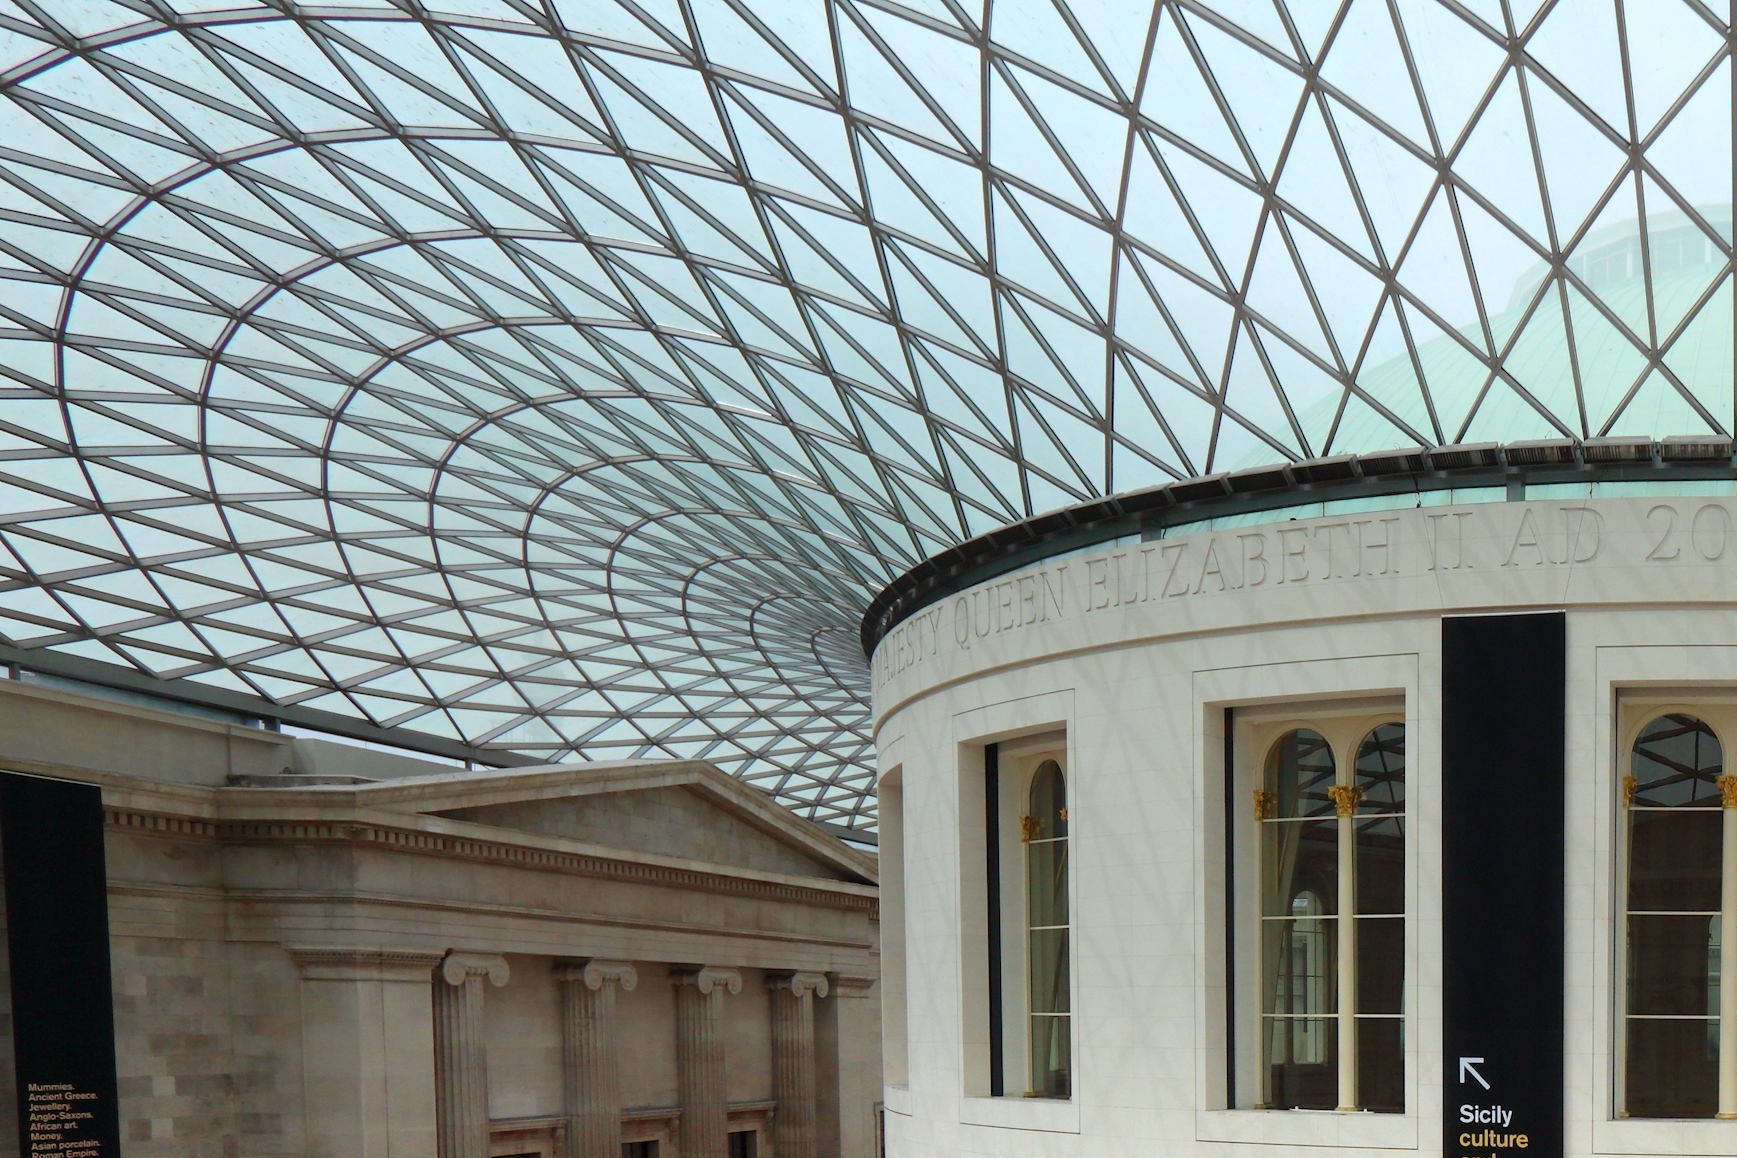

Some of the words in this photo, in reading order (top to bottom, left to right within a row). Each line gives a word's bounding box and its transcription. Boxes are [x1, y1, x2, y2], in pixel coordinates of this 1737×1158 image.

[954, 567, 1066, 650] QUEEN
[1085, 518, 1400, 612] ELIZABETH
[1428, 511, 1474, 571] II
[1500, 507, 1604, 566] AD
[28, 1083, 75, 1092] Mummies.
[28, 1093, 62, 1102] Ancient
[65, 1092, 98, 1100] Greece.
[29, 1103, 72, 1112] Jewellery.
[30, 1112, 94, 1122] Anglo-Saxons.
[1459, 1104, 1513, 1127] Sicily
[30, 1122, 62, 1131] African
[30, 1133, 62, 1141] Money.
[1459, 1129, 1529, 1148] culture
[31, 1142, 56, 1151] Asian
[59, 1140, 100, 1150] porcelain.
